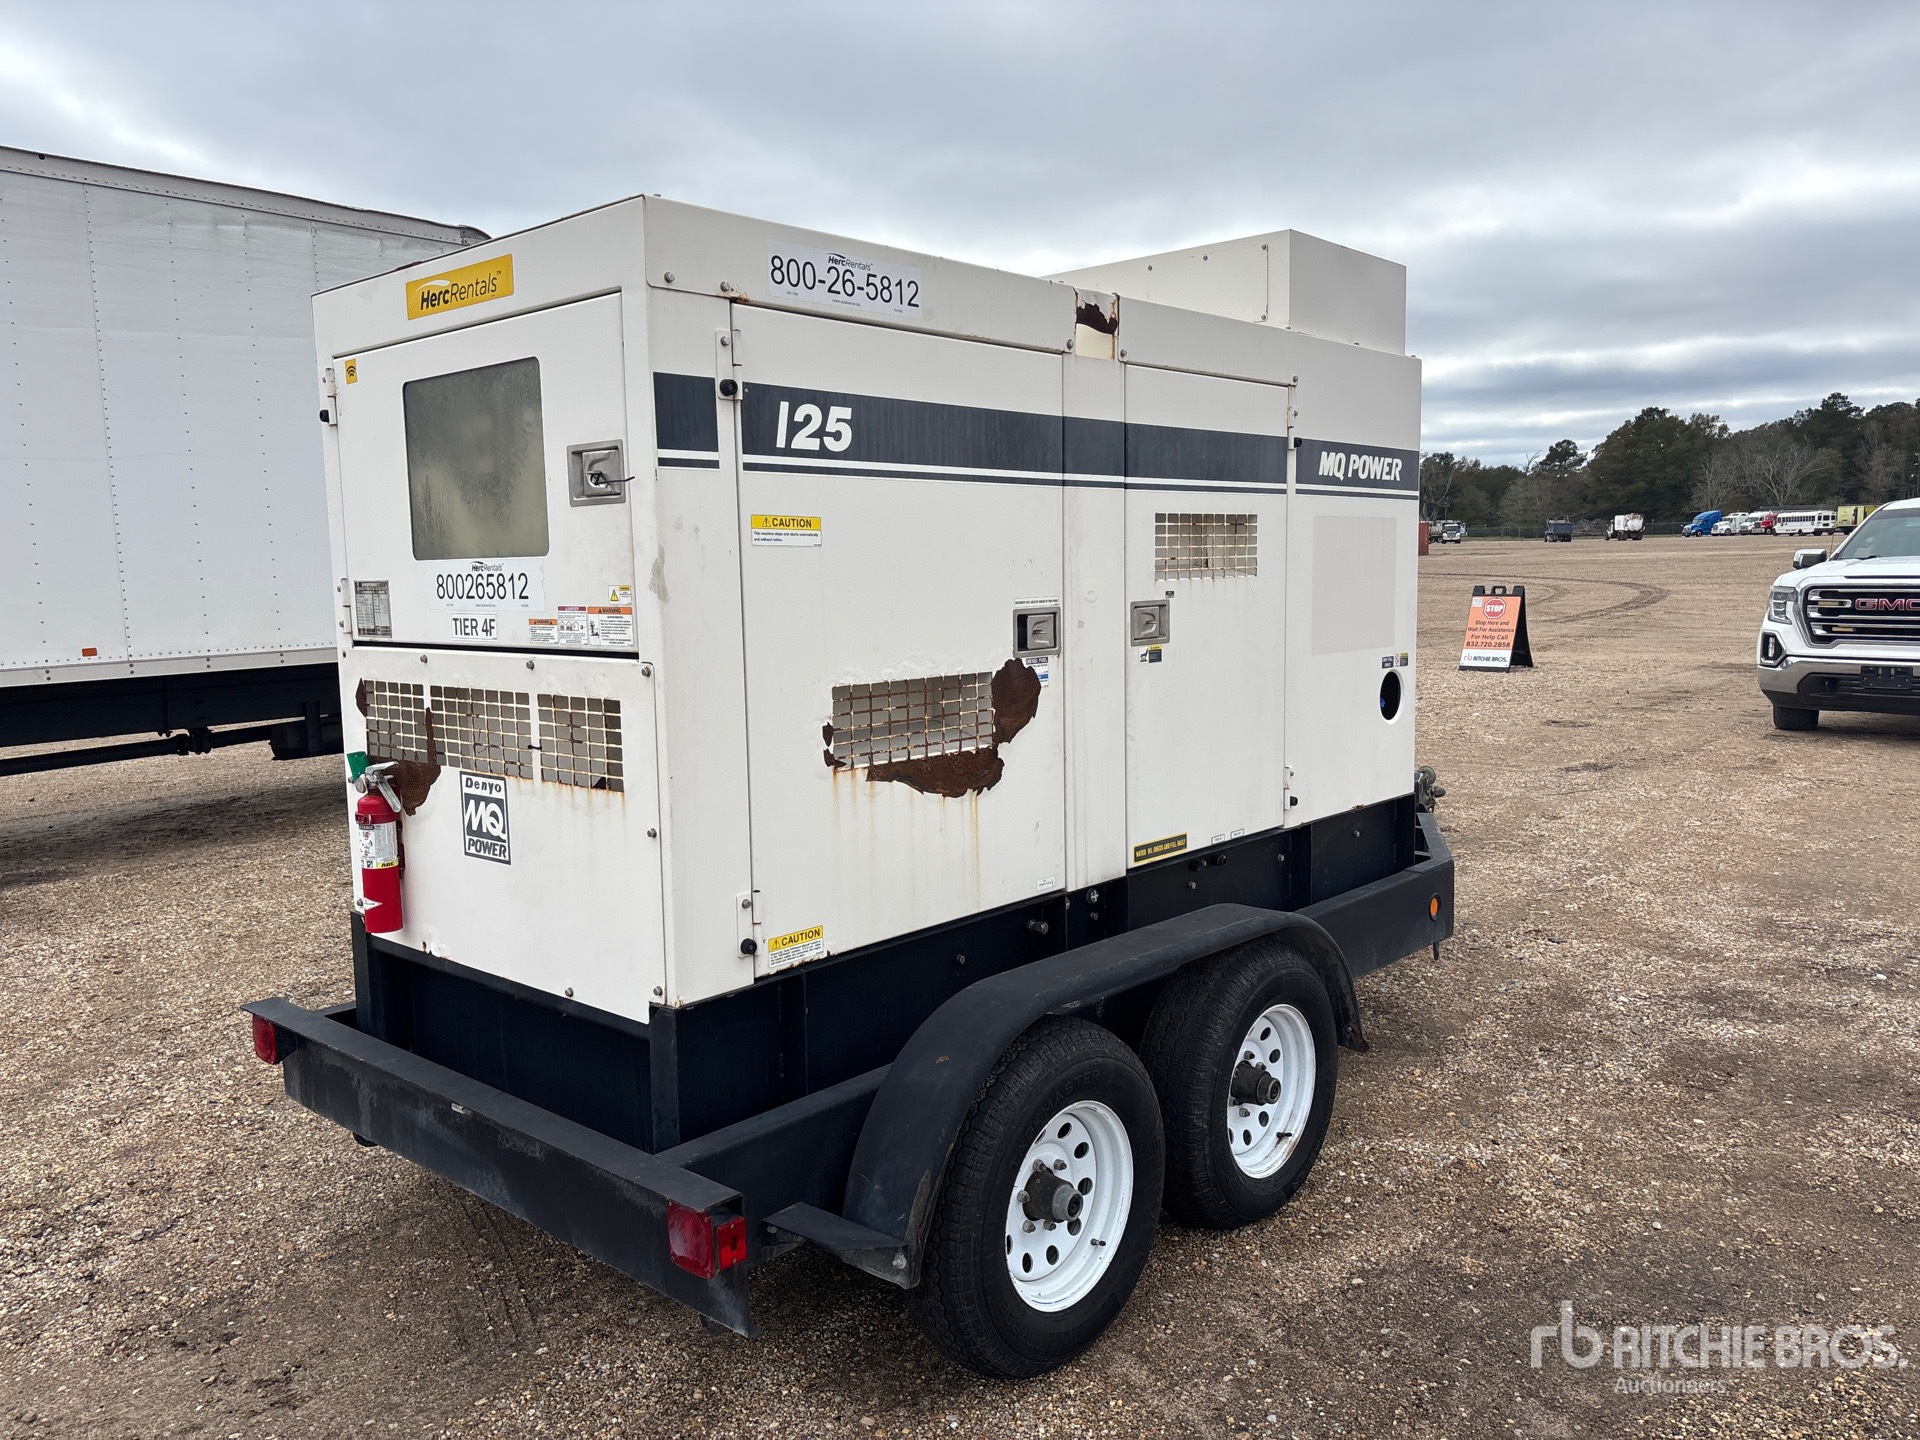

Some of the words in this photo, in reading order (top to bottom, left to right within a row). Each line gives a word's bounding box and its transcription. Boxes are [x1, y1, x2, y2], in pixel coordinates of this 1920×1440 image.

[770, 255, 920, 308] 800-26-5812
[776, 401, 853, 452] 125
[1319, 451, 1346, 482] MQ
[1347, 454, 1403, 482] POWER
[772, 517, 812, 528] CAUTION
[436, 573, 529, 600] 800265812
[1855, 597, 1920, 611] GMC
[452, 618, 478, 636] TIER
[481, 618, 496, 637] 4F
[465, 777, 502, 794] Denyo
[465, 799, 507, 841] MQ
[467, 838, 507, 859] POWER
[781, 928, 820, 946] CAUTION
